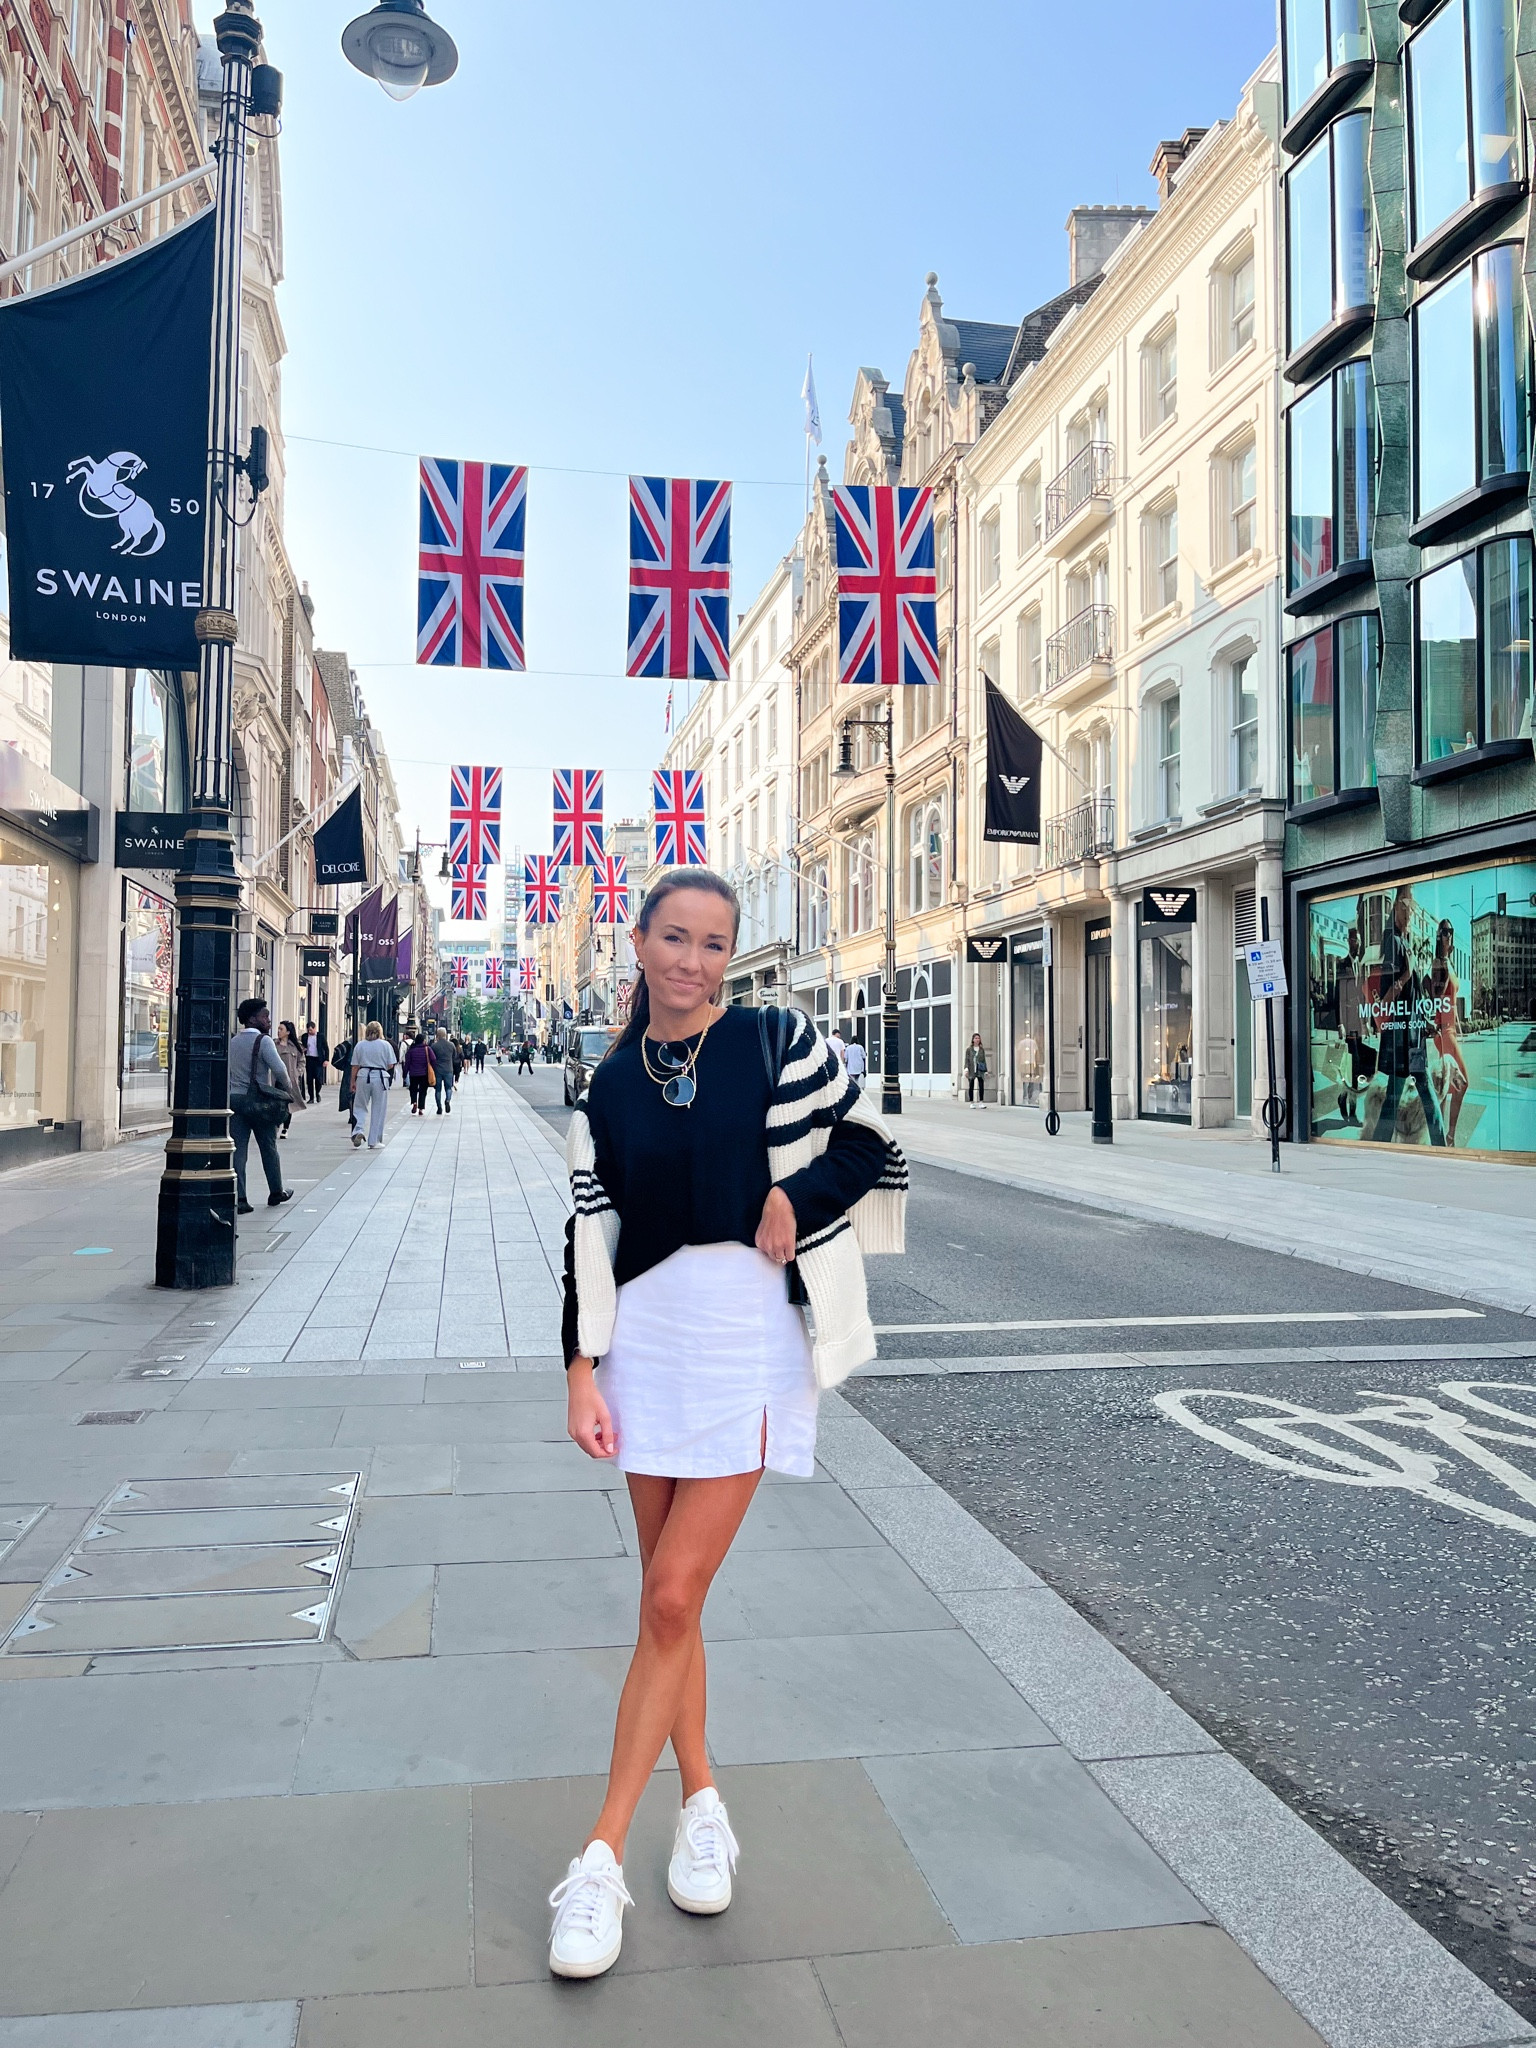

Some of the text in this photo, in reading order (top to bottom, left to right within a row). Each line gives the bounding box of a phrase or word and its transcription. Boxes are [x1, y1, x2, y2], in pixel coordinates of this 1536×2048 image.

[31, 481, 200, 515] 17 50
[36, 568, 201, 608] SWAINE
[96, 611, 146, 623] LONDON
[125, 838, 185, 850] SWAINE
[379, 938, 394, 946] OSS
[1359, 997, 1451, 1018] MICHAEL KORS
[1380, 1020, 1427, 1030] OPENING SOON
